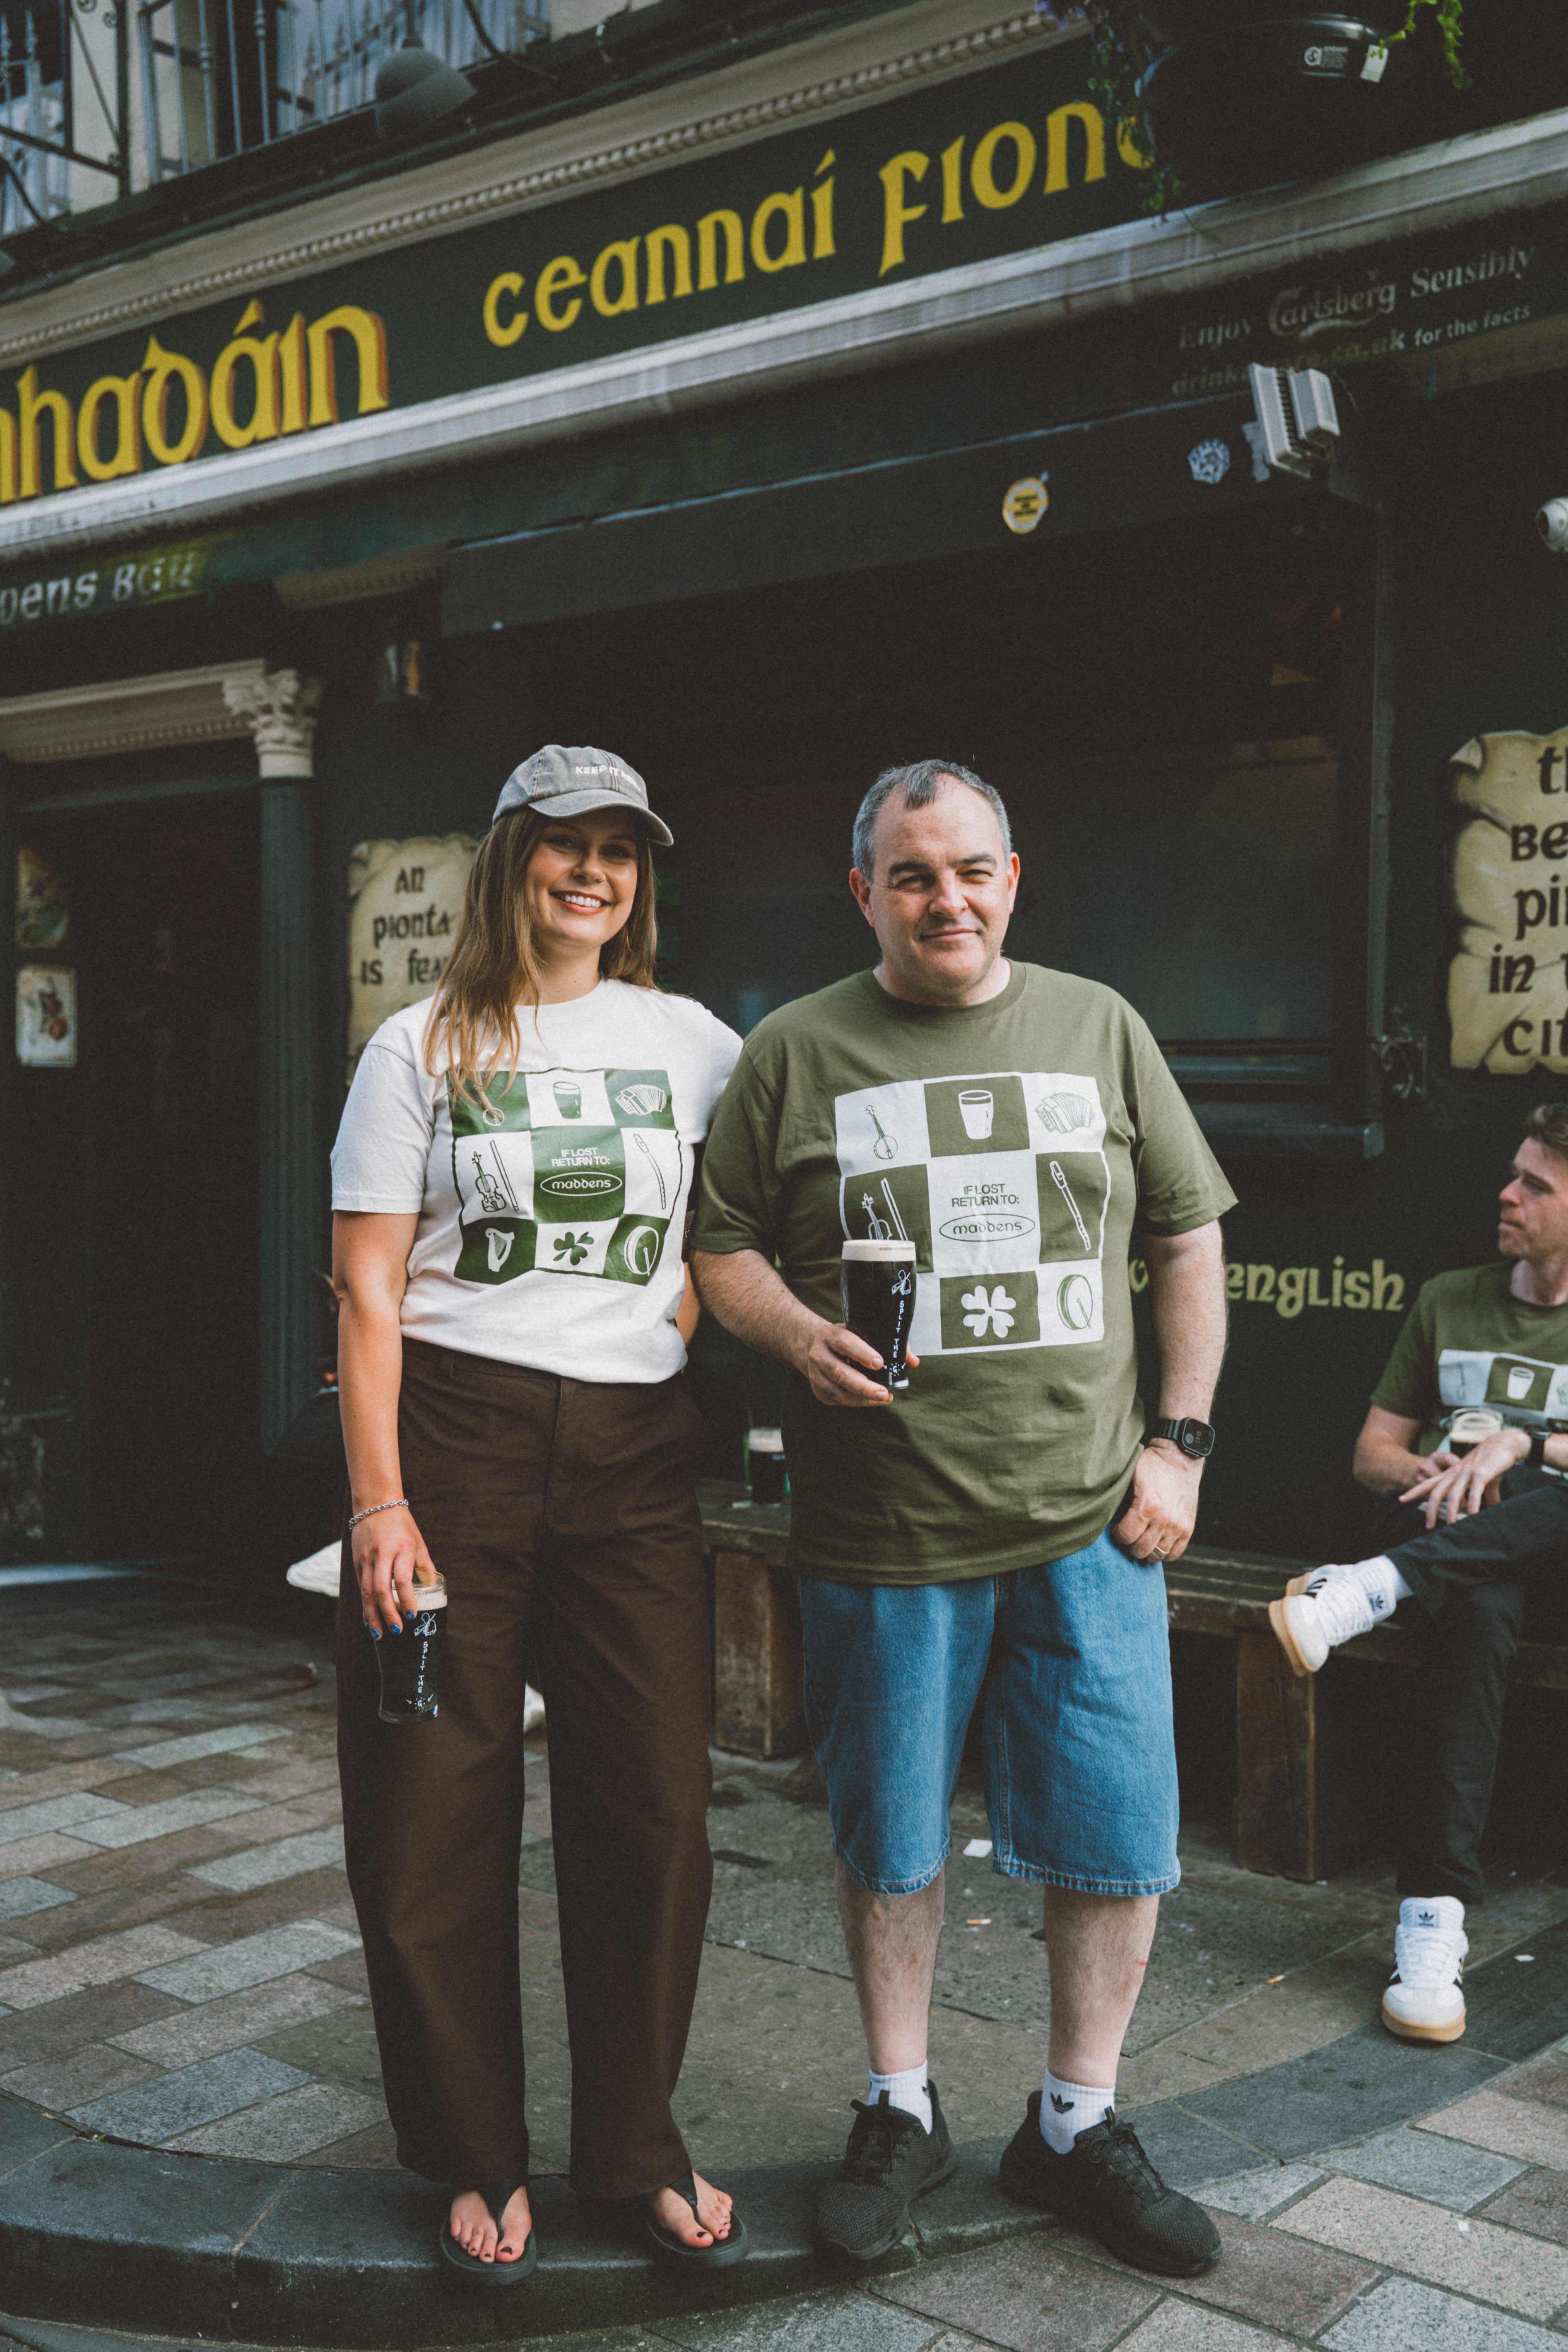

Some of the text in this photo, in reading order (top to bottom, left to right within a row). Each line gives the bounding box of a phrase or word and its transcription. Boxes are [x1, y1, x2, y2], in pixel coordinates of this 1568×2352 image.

[483, 149, 836, 347] ceannaí
[1178, 248, 1536, 349] Enjoy Carlsberg Sensibly
[1414, 326, 1440, 348] for
[1446, 313, 1478, 336] the
[1483, 304, 1531, 329] facts
[575, 765, 607, 774] KEEP
[609, 766, 619, 776] IT
[1537, 746, 1568, 795] t
[1514, 874, 1568, 941] pi
[361, 959, 383, 985] is
[1489, 944, 1536, 994] in
[551, 1156, 611, 1167] RETURN TO:
[561, 1147, 598, 1158] IF LOST
[552, 1177, 611, 1189] maddens
[963, 1183, 1006, 1195] IF LOST
[951, 1194, 1019, 1207] RETURN TO:
[953, 1221, 1022, 1234] maddens
[896, 1300, 905, 1333] SPLIT
[420, 1641, 429, 1671] SPLIT
